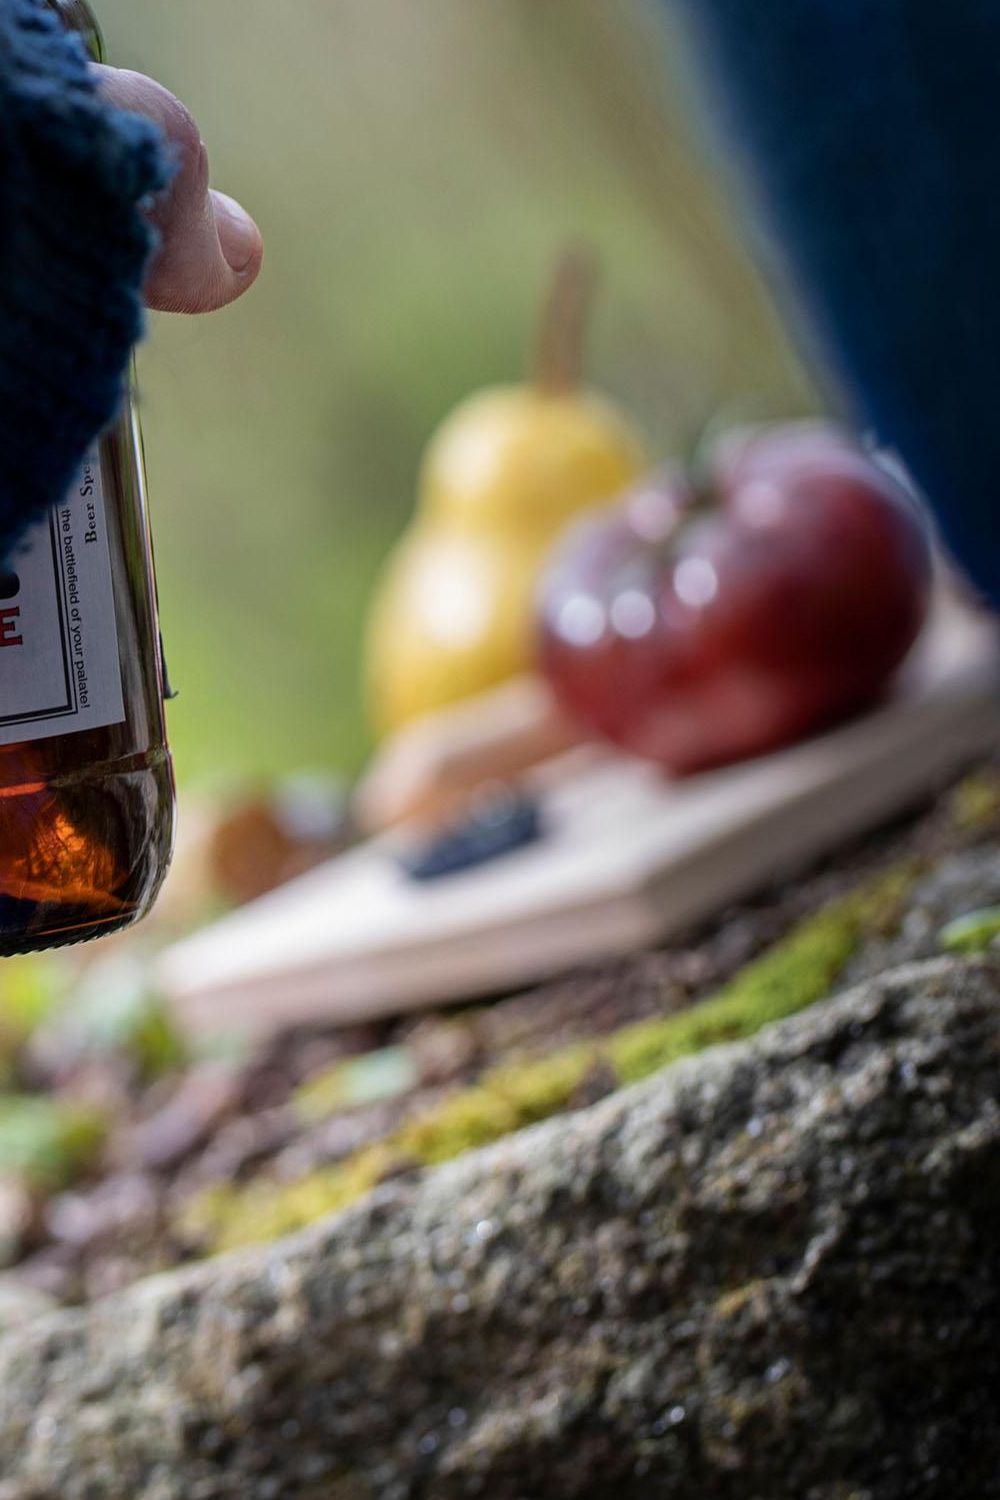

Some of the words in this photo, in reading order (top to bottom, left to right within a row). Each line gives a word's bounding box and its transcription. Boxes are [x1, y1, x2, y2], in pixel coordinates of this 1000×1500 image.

[61, 509, 72, 532] the
[85, 503, 98, 543] Beer
[63, 536, 80, 605] battlefield
[71, 608, 82, 622] of
[71, 624, 84, 657] your
[74, 660, 91, 708] palate!
